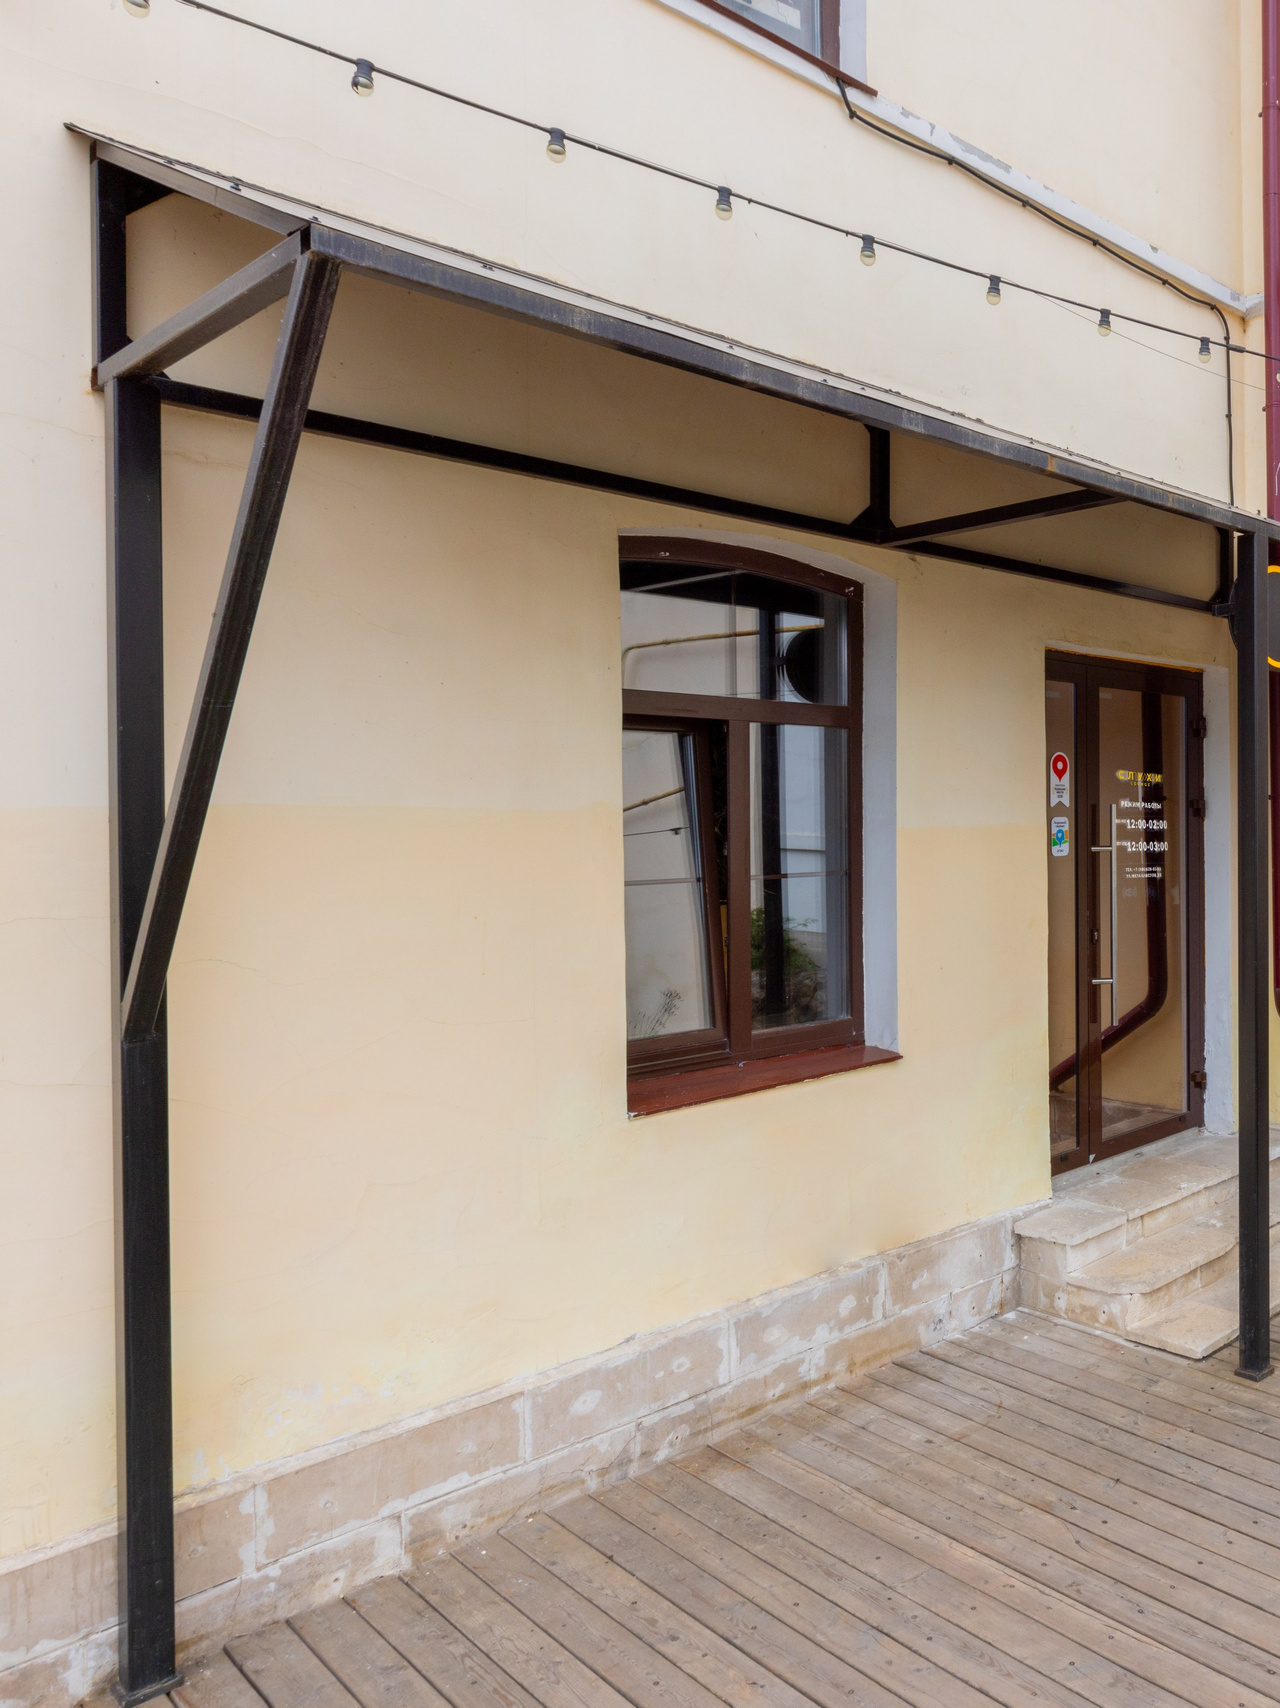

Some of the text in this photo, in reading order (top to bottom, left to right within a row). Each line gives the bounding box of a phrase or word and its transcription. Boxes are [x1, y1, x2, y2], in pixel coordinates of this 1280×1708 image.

[1116, 769, 1163, 783] СЛУХИ
[1120, 800, 1162, 809] РЕЖИМ РАБОТЫ
[1126, 819, 1168, 829] 12:00-02:00
[1127, 841, 1169, 852] 12:00-03:00
